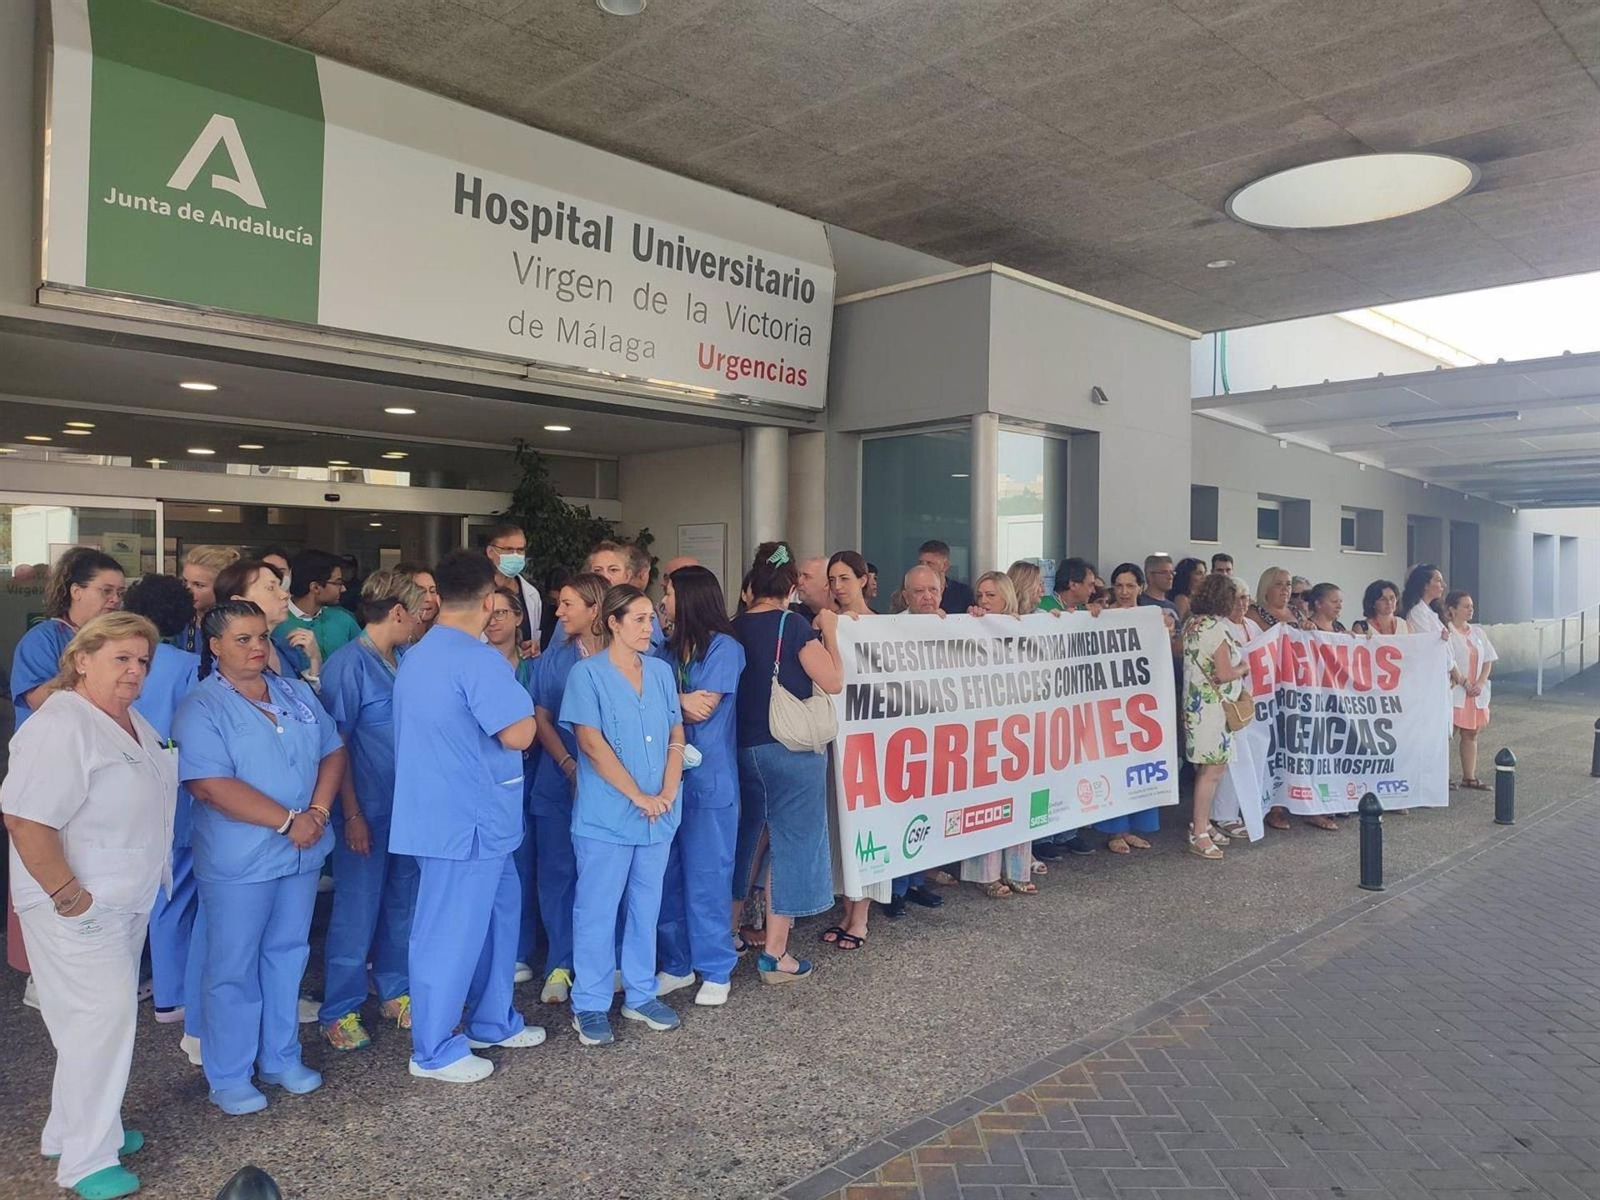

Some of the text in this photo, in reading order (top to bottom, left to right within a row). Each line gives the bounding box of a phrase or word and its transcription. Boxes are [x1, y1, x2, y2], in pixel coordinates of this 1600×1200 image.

[104, 187, 313, 246] Junta de Andalucía
[454, 172, 815, 304] Hospital Universitario
[512, 250, 811, 346] Virgen de la Victoria
[508, 310, 656, 362] de Málaga
[698, 342, 807, 387] Urgencias
[855, 638, 988, 674] NECESITAMOS
[993, 637, 1013, 665] DE
[1067, 627, 1141, 658] INMEDIATA
[845, 656, 1150, 721] MEDIDAS EFICACES CONTRA LAS
[1381, 695, 1403, 714] EN
[842, 693, 1163, 812] AGRESIONES
[1126, 761, 1168, 787] FTPS
[1317, 759, 1331, 775] DEL
[1334, 758, 1395, 775] HOSPITAL
[1377, 780, 1409, 793] FTPS
[908, 826, 931, 844] CSIF
